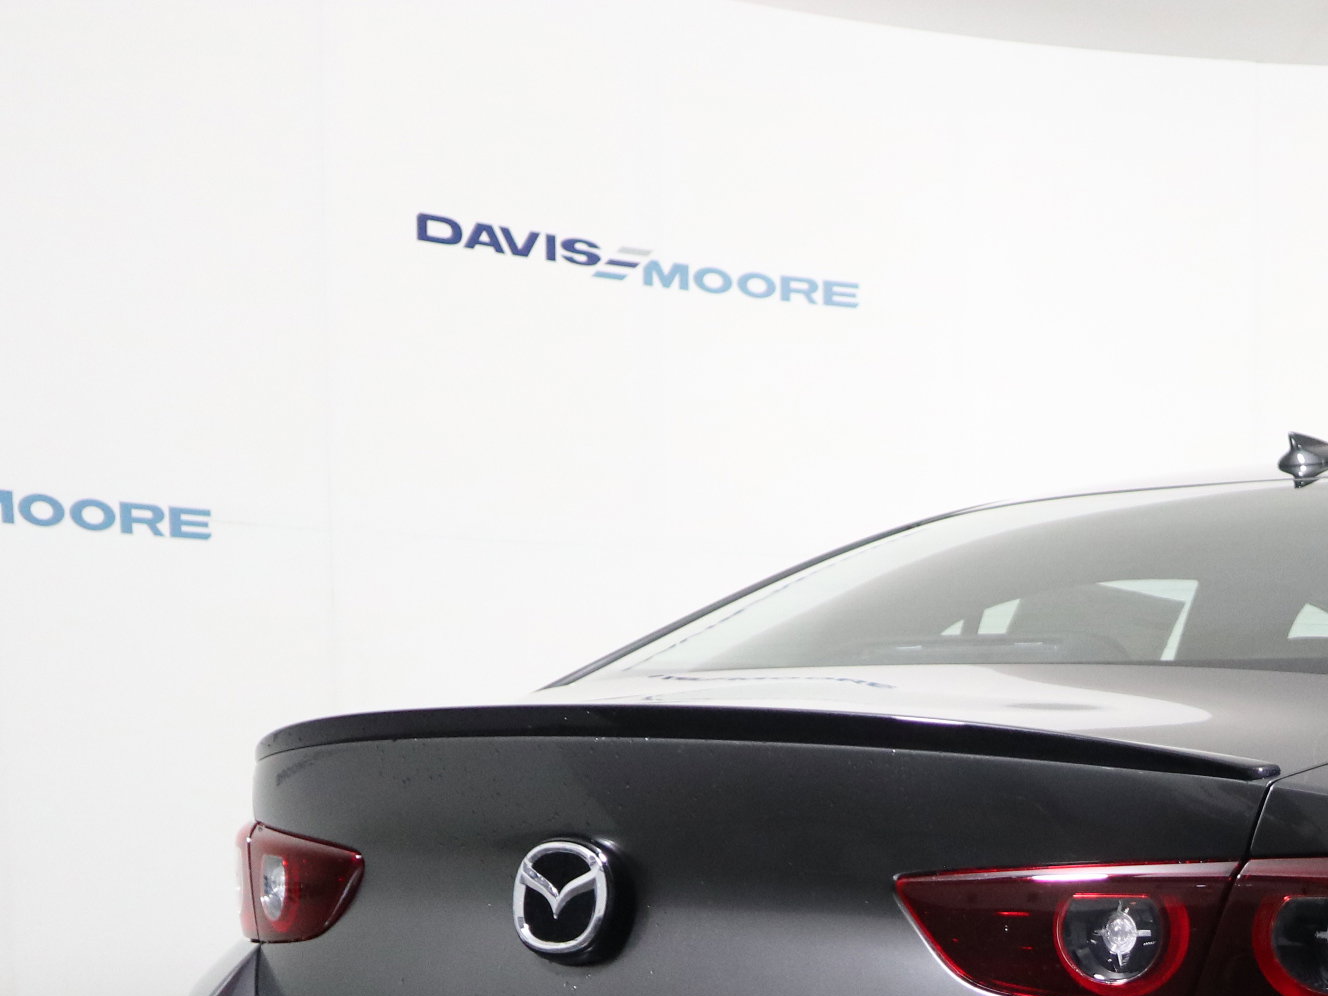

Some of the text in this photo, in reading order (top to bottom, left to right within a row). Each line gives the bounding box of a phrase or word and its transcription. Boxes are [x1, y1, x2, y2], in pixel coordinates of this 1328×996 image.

[416, 212, 860, 310] DAVIS MOORE
[0, 489, 212, 541] OORE
